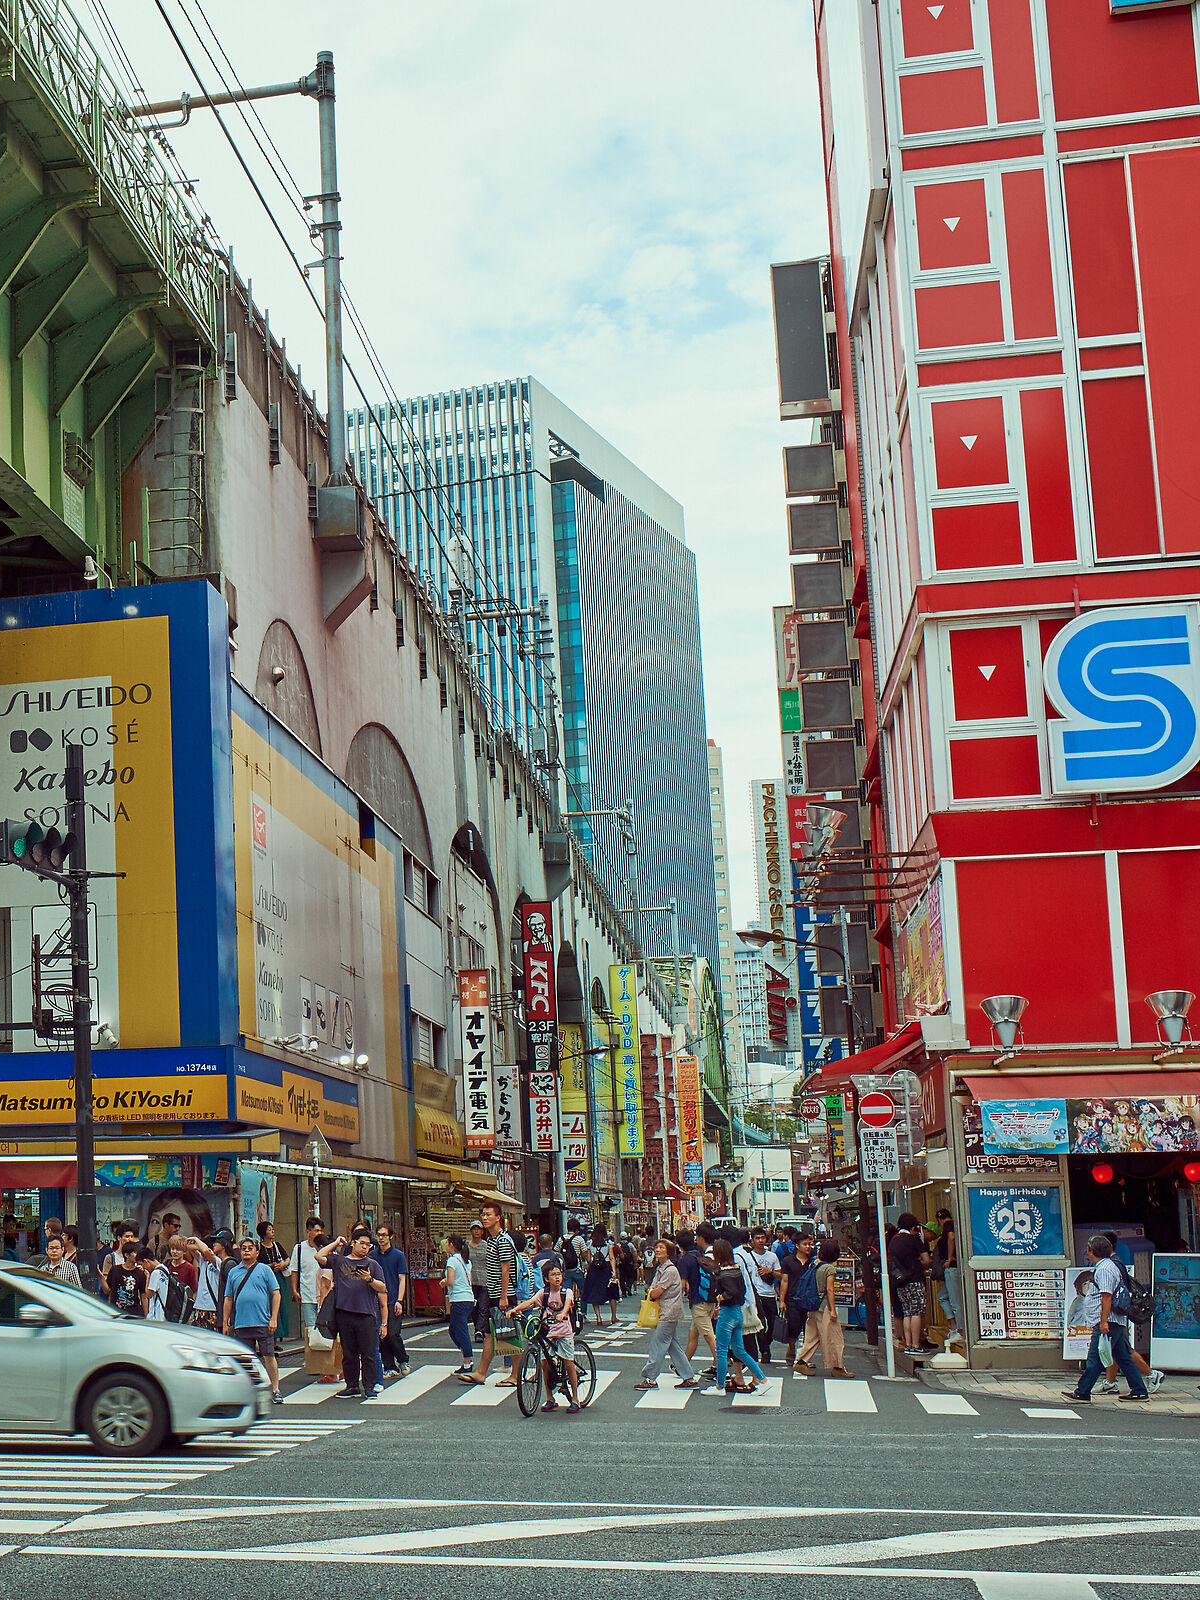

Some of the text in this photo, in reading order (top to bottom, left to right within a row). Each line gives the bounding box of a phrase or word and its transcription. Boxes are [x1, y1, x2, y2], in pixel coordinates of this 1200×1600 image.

[61, 719, 139, 749] KOSÉ
[791, 785, 802, 794] 6F
[24, 802, 130, 828] SONA
[761, 783, 786, 958] PACHINKO & SLOT
[255, 884, 288, 922] SHISEIDO
[258, 960, 284, 995] Kanebo
[529, 957, 550, 1014] KFC
[531, 1032, 553, 1043] 客席
[464, 1011, 490, 1131] オヤイデ電気
[112, 1089, 193, 1110] KiYoshi
[241, 1089, 268, 1111] Matsumoto
[802, 1105, 820, 1114] 消火栓
[989, 1108, 1059, 1120] ラブライブ!
[536, 1099, 553, 1150] お弁当
[863, 1131, 895, 1139] 自転車を除く
[467, 1138, 494, 1147] 通信販売
[967, 1155, 1044, 1168] UFOキャッチャー
[979, 1188, 1047, 1198] Happy Birthday
[999, 1237, 1033, 1245] Anniversary
[996, 1244, 1010, 1254] since
[976, 1271, 1002, 1280] FLOOR
[977, 1281, 1003, 1290] GUIDE
[982, 1312, 1001, 1320] 10:00
[982, 1328, 1003, 1336] 23:30
